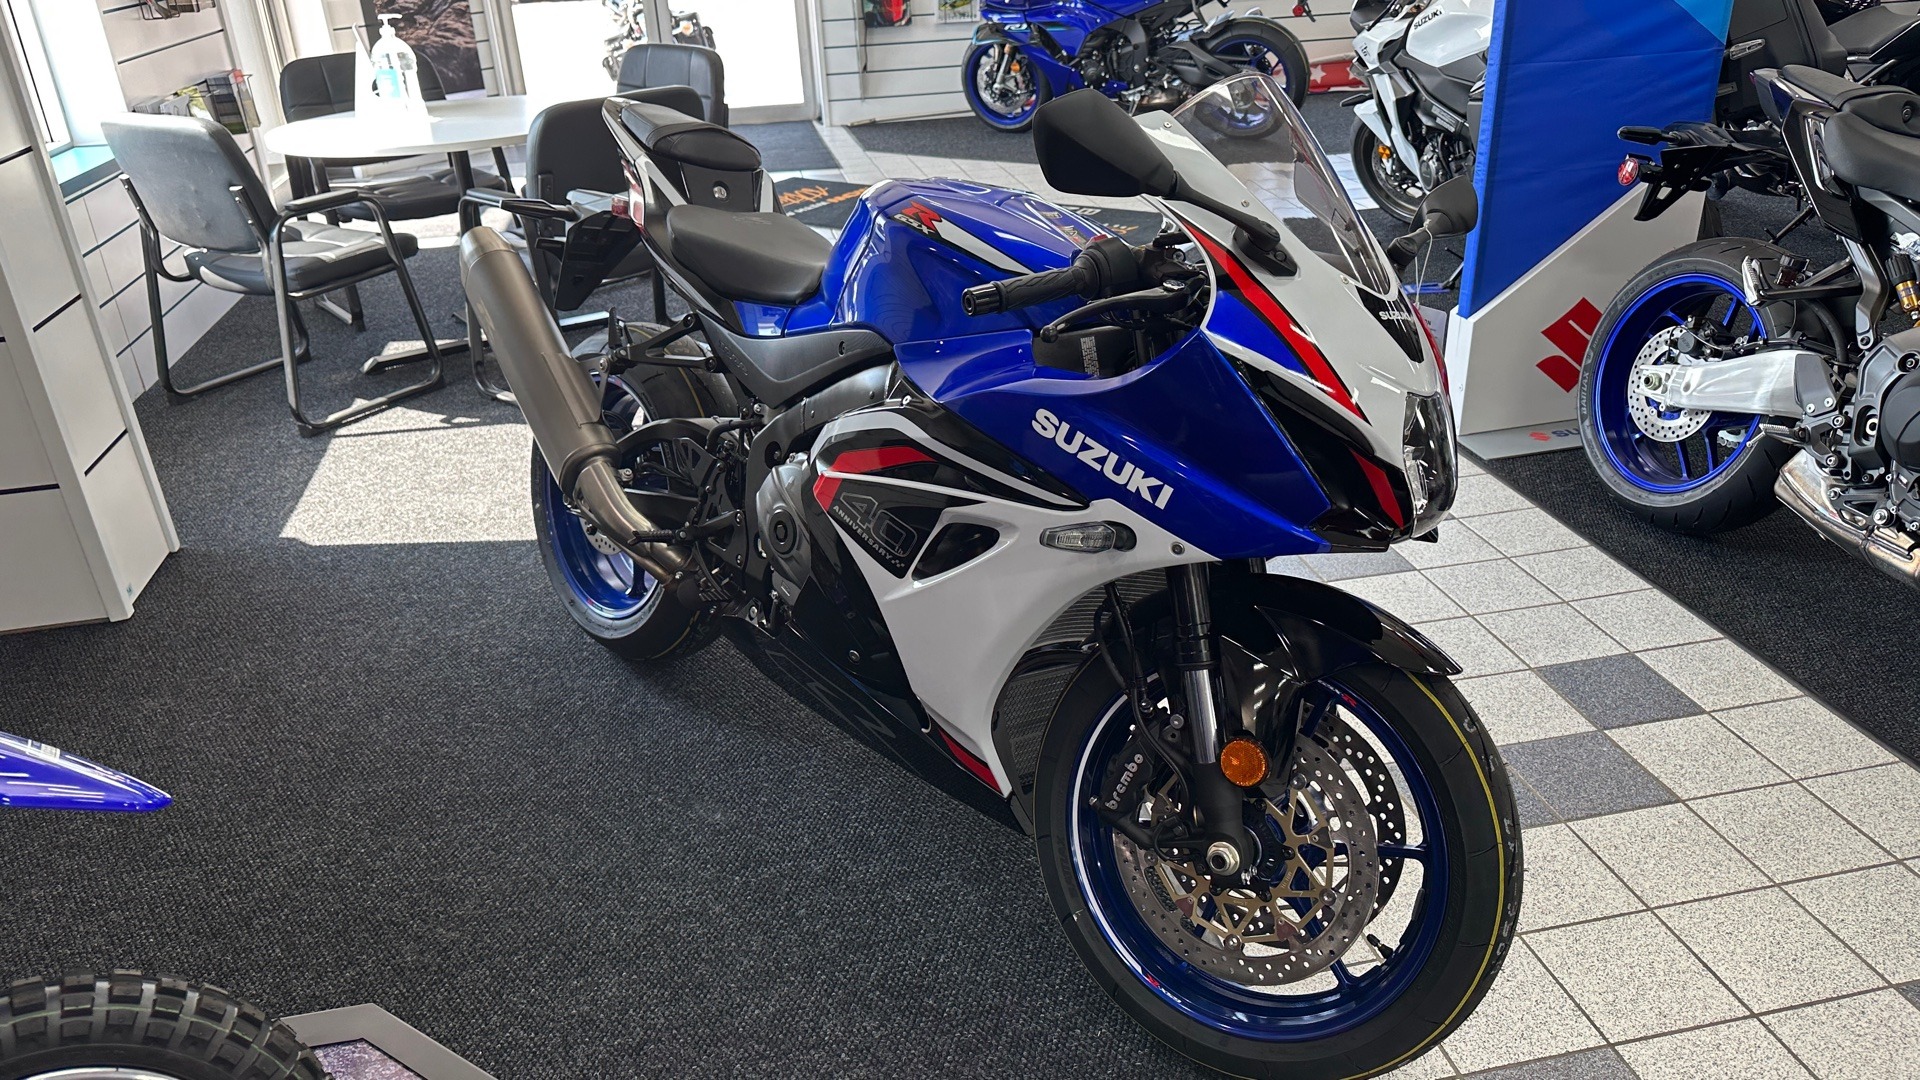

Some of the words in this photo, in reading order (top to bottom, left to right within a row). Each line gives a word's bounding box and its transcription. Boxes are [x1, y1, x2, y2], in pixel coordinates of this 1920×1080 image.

[1413, 9, 1443, 30] SUZUKI
[893, 213, 936, 234] GSX
[901, 200, 942, 231] R
[1031, 408, 1174, 510] SUZUKI
[832, 505, 893, 560] ANNIVERSARY
[1104, 753, 1144, 810] brembo
